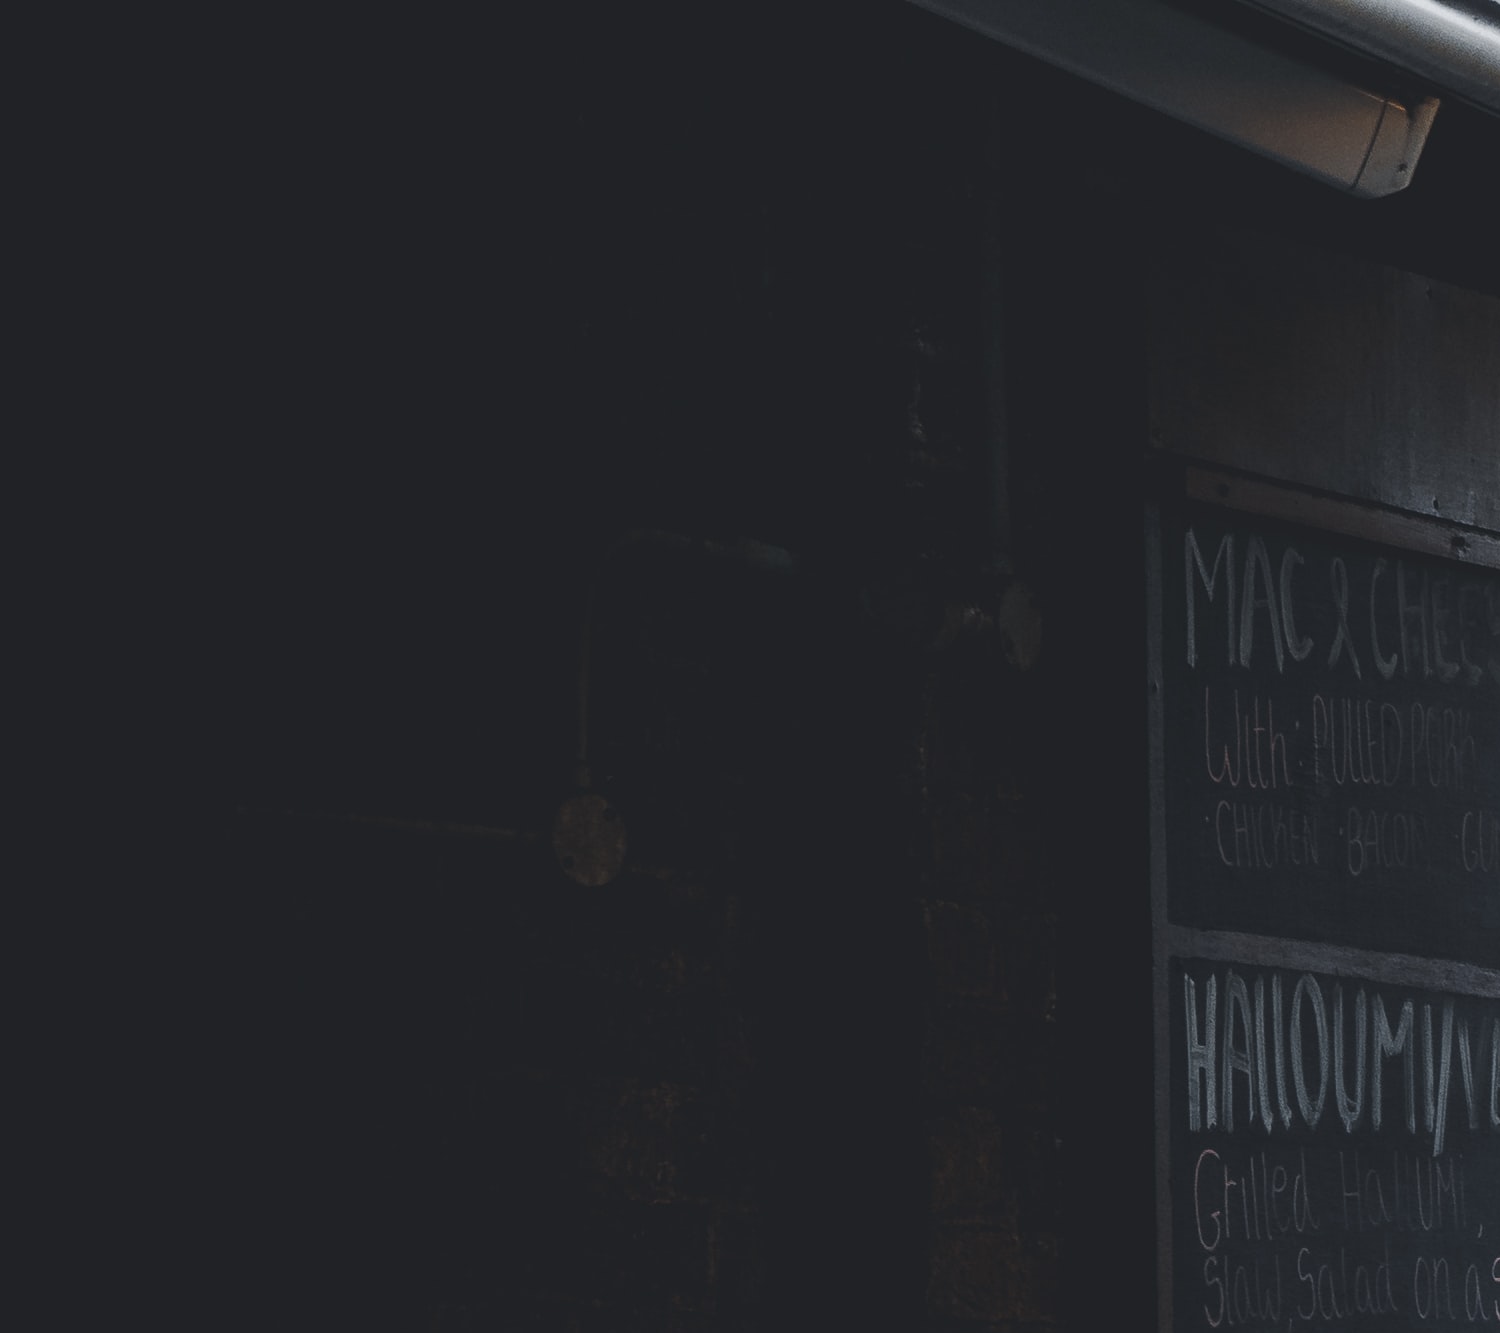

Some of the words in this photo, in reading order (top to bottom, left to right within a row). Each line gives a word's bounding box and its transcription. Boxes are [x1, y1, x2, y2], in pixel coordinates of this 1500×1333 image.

[1184, 525, 1314, 674] MAC
[1194, 1149, 1321, 1251] Grilled
[1414, 1256, 1457, 1320] on
[1465, 1264, 1492, 1320] a
